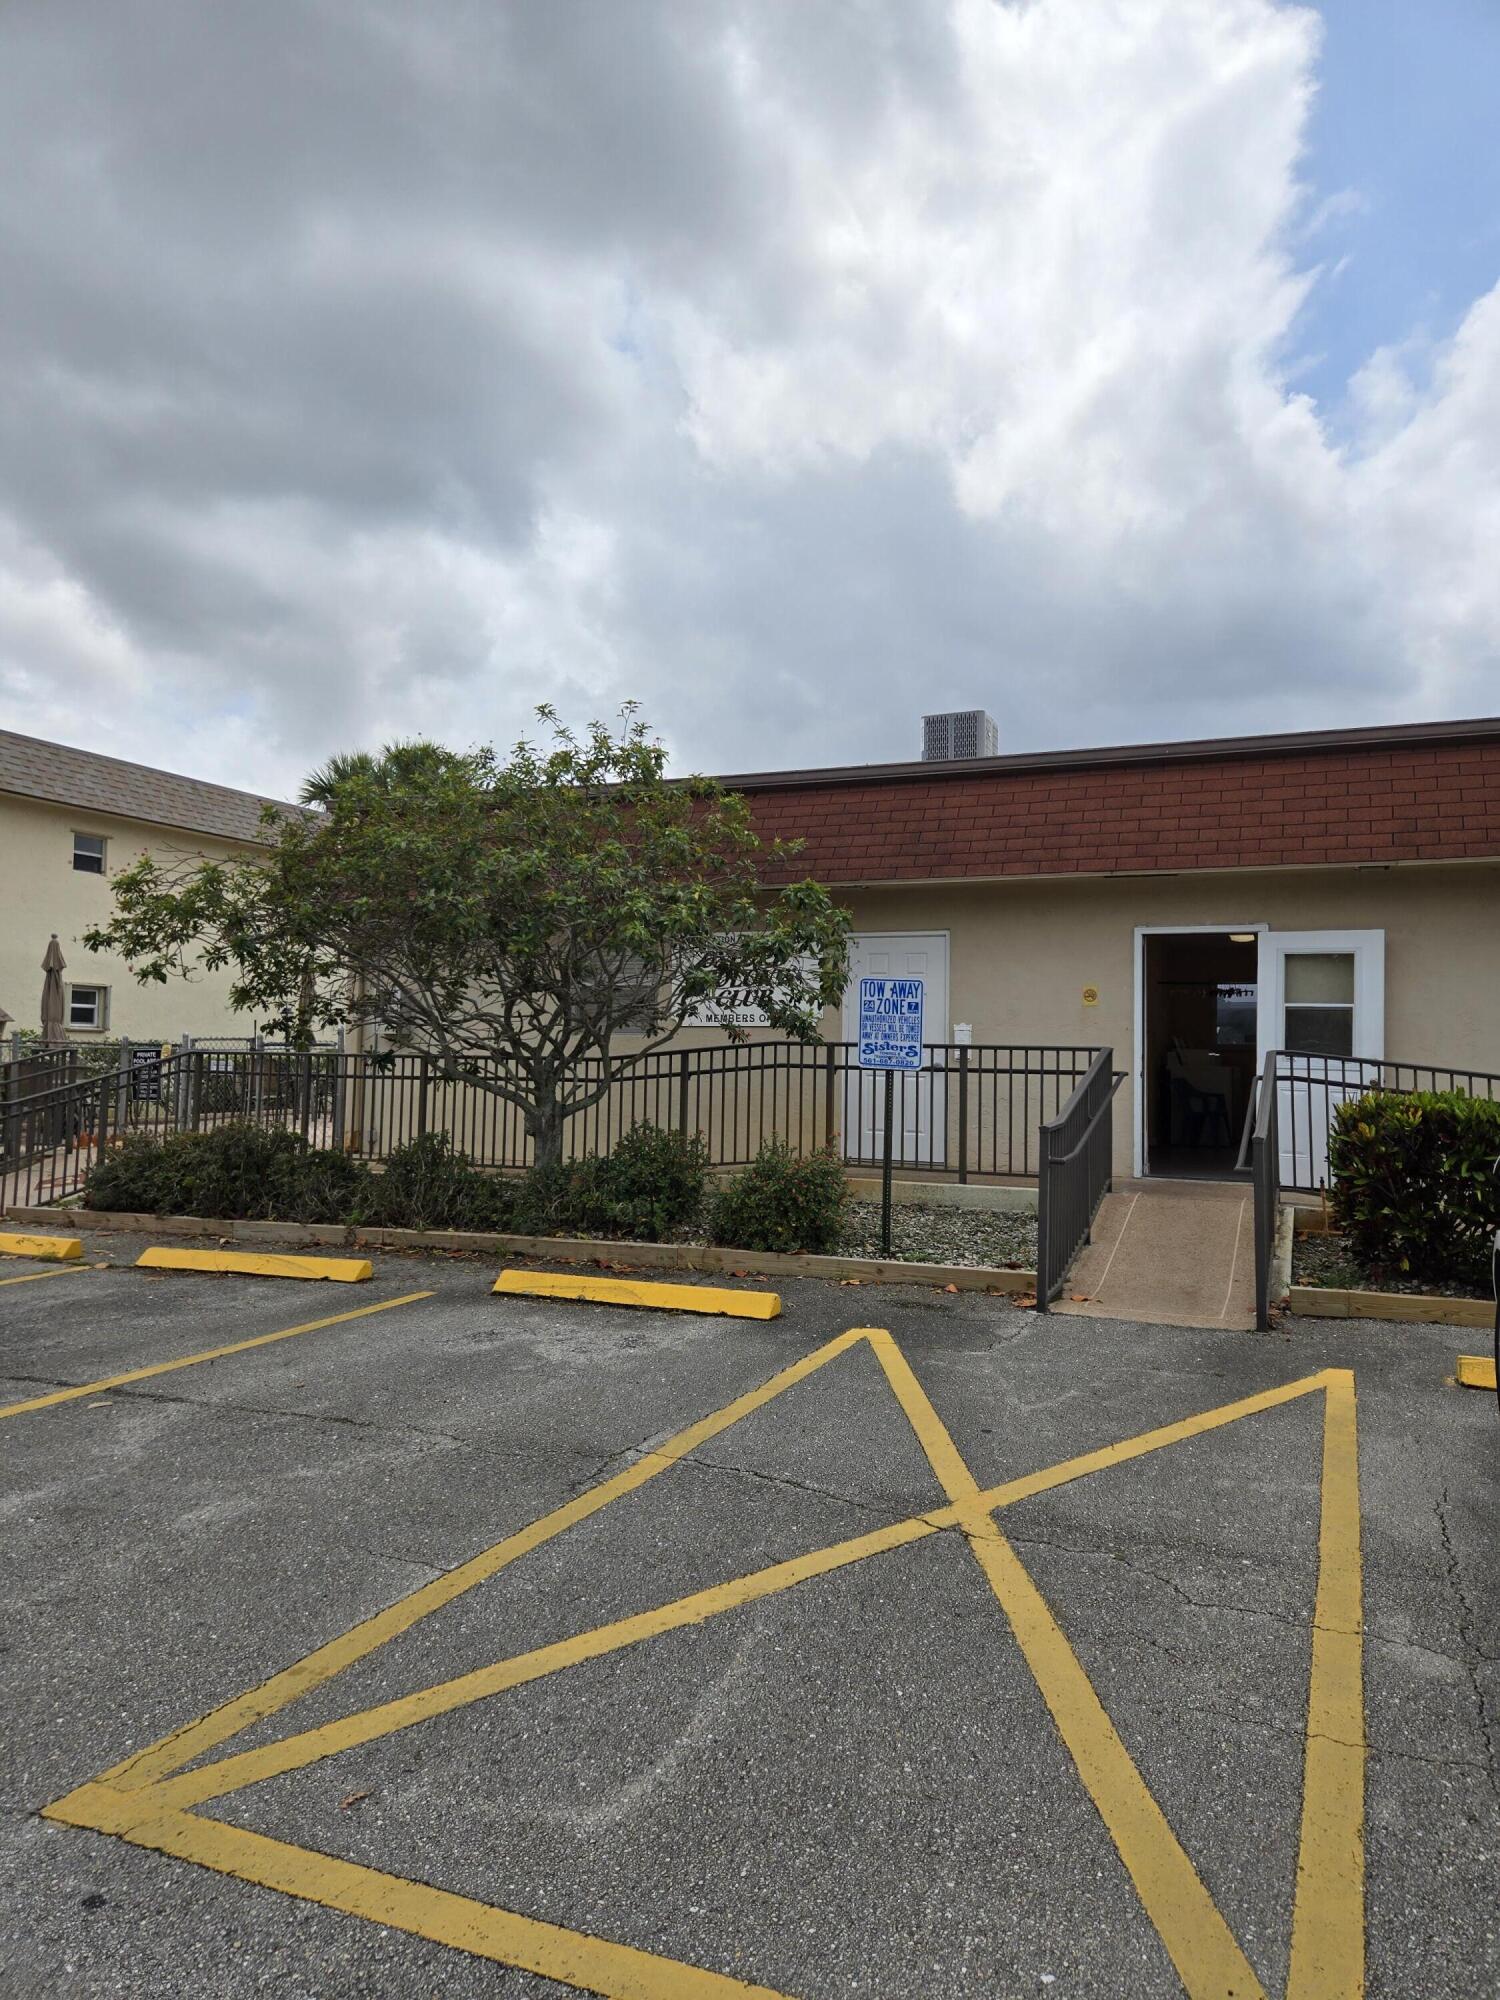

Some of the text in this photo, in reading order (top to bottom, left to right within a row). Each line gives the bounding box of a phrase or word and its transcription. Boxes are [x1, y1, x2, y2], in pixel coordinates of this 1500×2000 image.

[863, 981, 920, 999] TOW AWAY
[876, 998, 906, 1015] ZONE
[705, 1014, 755, 1023] MEMBERS
[862, 1015, 920, 1025] UNAUTHORIZED VEHICLES
[869, 1023, 887, 1032] VESSELS
[888, 1024, 897, 1033] WILL
[899, 1024, 905, 1033] BE
[905, 1025, 920, 1034] TOWED
[862, 1032, 873, 1040] AWAY
[881, 1033, 898, 1042] OWNERS
[900, 1033, 920, 1042] EXPENSE
